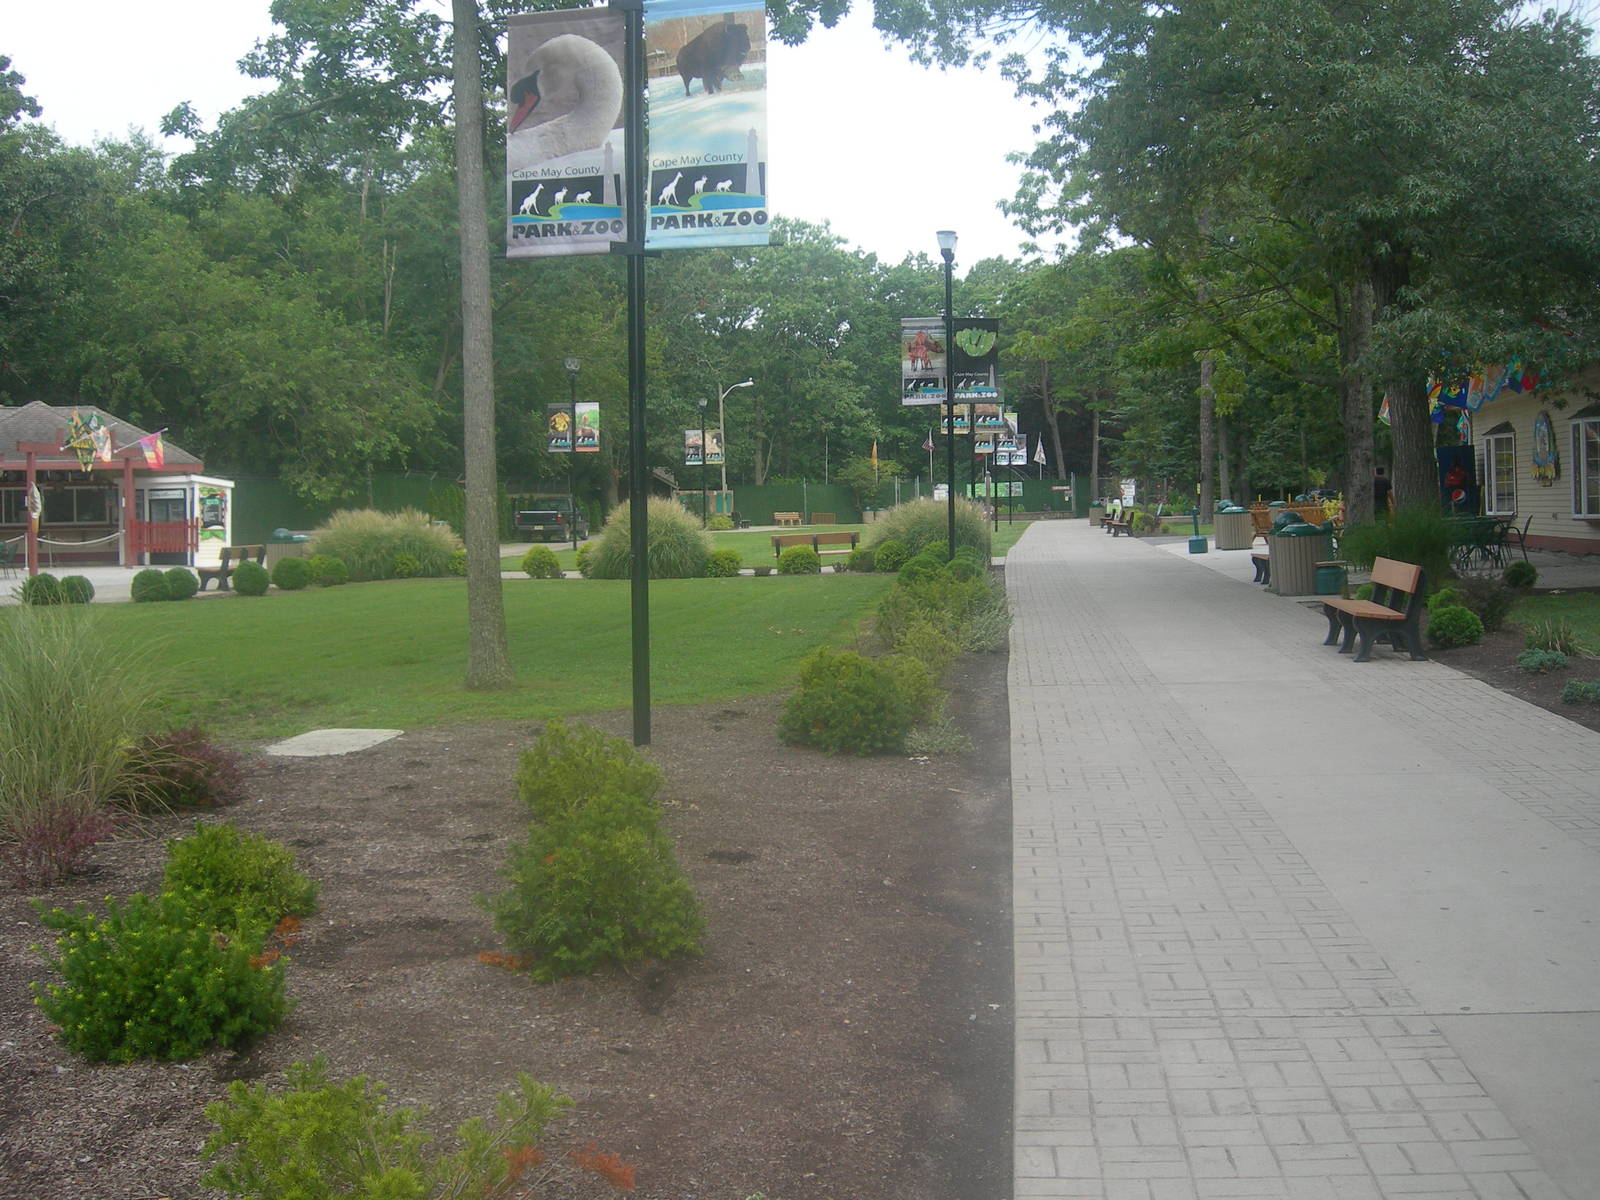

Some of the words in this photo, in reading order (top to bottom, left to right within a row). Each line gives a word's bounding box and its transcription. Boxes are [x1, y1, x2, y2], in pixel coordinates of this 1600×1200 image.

[652, 158, 678, 168] Cape
[680, 156, 702, 165] May
[704, 153, 744, 162] County
[512, 169, 538, 179] Cape
[541, 167, 561, 178] May
[565, 166, 600, 175] County
